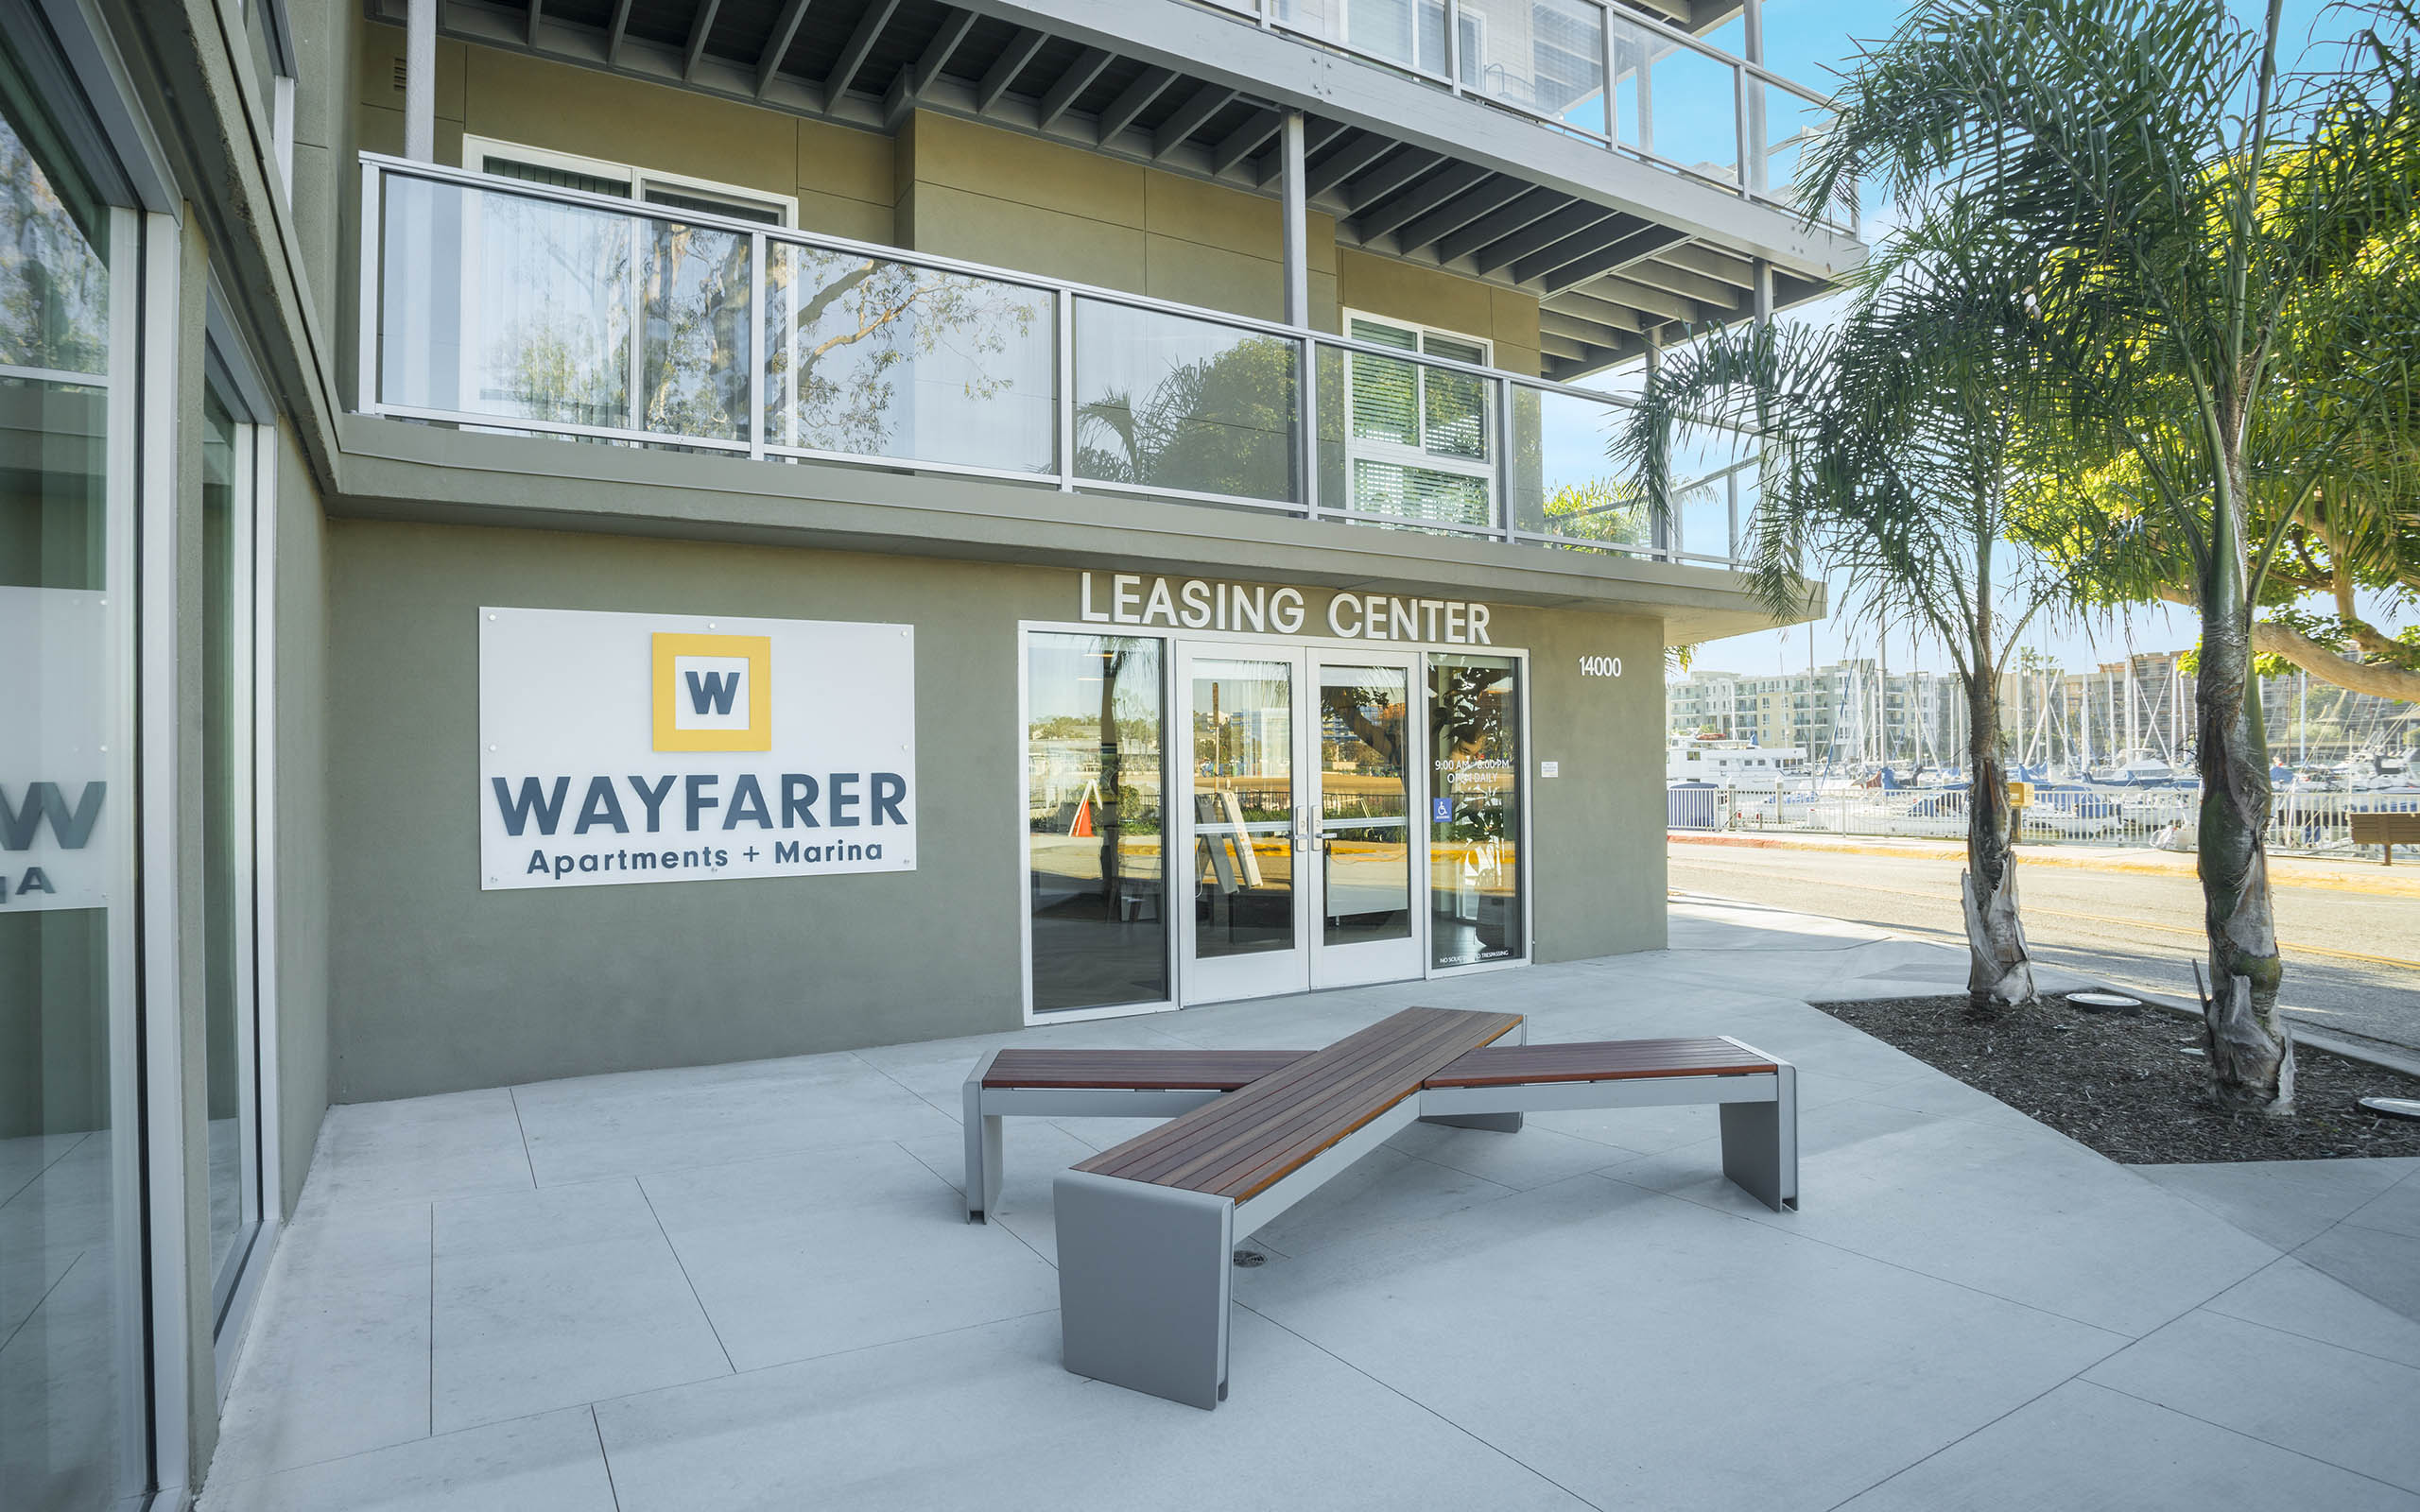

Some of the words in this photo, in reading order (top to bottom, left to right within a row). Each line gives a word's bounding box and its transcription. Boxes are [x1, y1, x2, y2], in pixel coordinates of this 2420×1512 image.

[1081, 572, 1305, 634] LEASING
[1327, 593, 1492, 645] CENTER
[1579, 656, 1622, 677] 14000
[684, 671, 740, 714] W
[1435, 760, 1454, 770] 9:00
[1456, 760, 1470, 770] AM
[1496, 759, 1510, 769] PM
[1474, 772, 1498, 783] DAILY
[492, 773, 908, 836] WAYFARER
[527, 846, 729, 880] Apartments
[743, 845, 761, 863] +
[775, 839, 883, 864] Marina
